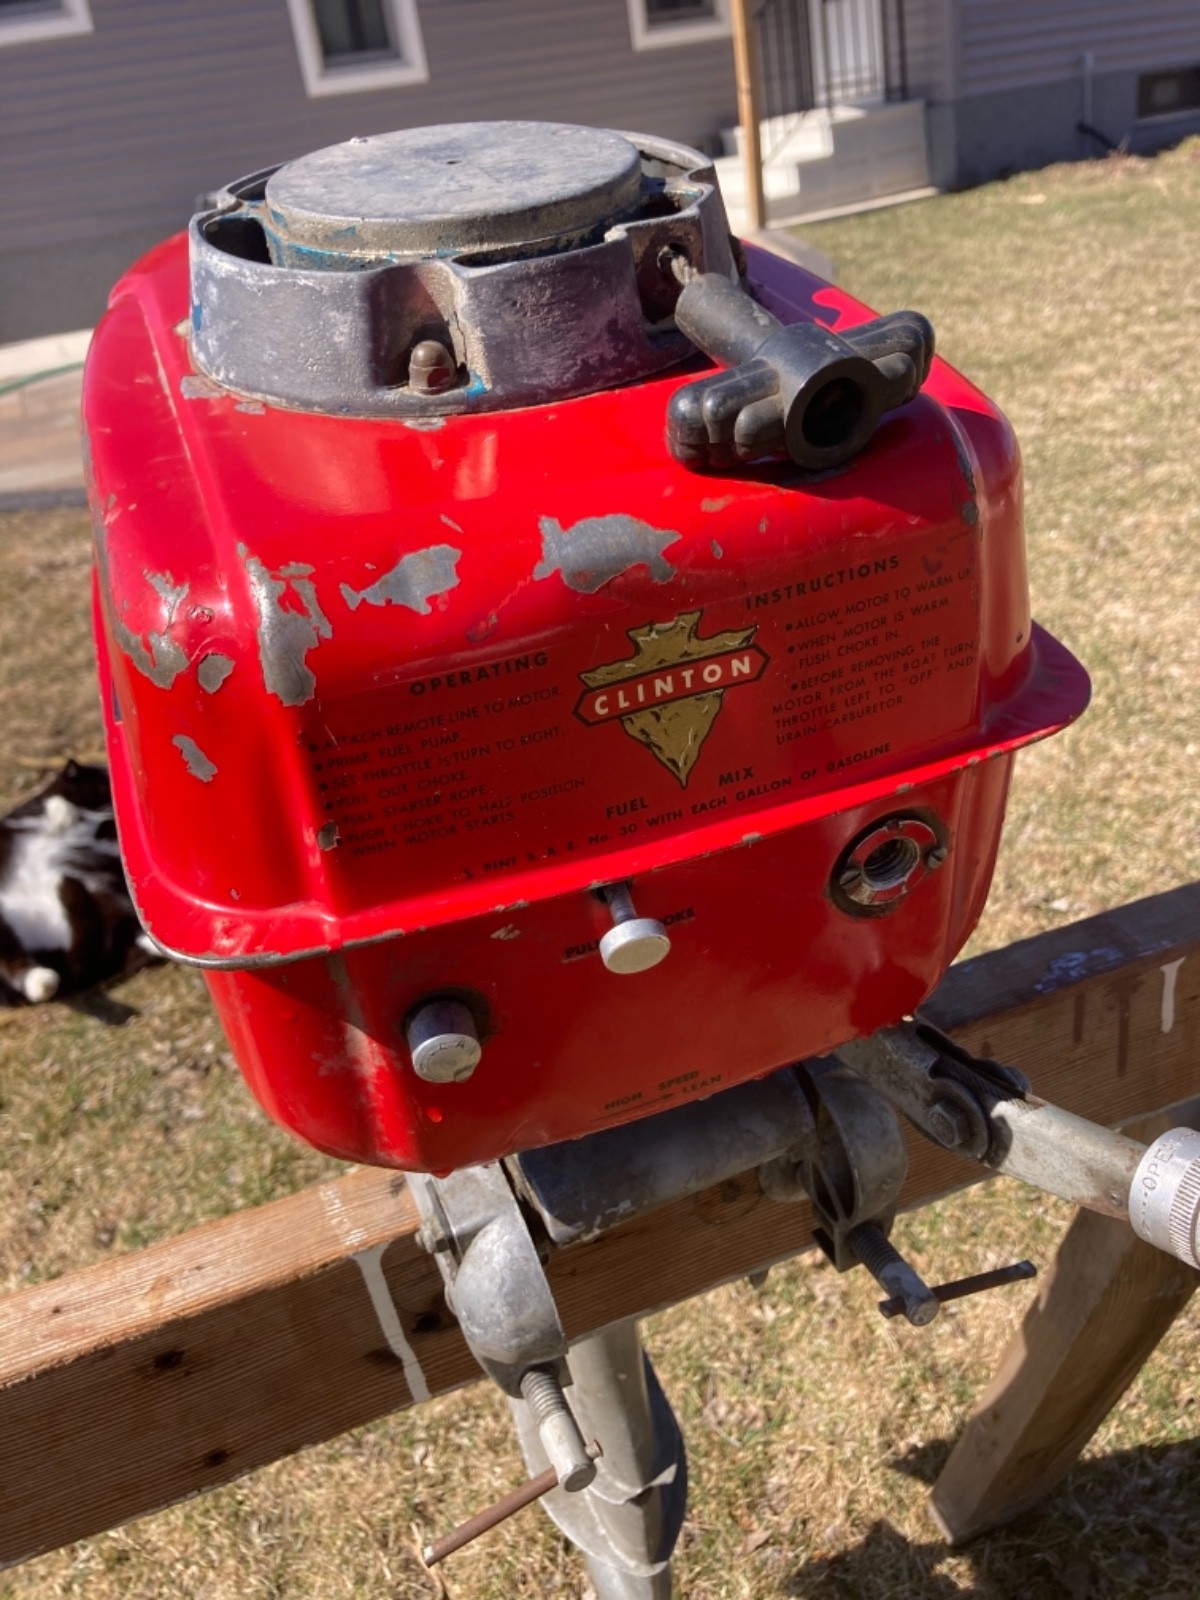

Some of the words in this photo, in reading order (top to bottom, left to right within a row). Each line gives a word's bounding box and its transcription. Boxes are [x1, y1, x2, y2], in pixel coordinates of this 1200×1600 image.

[745, 556, 900, 610] INSTRUCTIONS
[796, 609, 839, 630] ALLOW
[845, 593, 889, 617] MOTOR
[895, 587, 910, 600] TO
[916, 574, 953, 593] WARM
[798, 632, 836, 652] WHEN
[843, 616, 887, 639] MOTOR
[893, 610, 904, 623] IS
[911, 598, 949, 617] WARM
[837, 636, 878, 657] CHOKE
[885, 630, 898, 642] IN
[410, 651, 549, 696] OPERATING
[772, 691, 822, 714] MOTOR
[829, 677, 865, 695] FROM
[873, 667, 895, 681] THE
[902, 652, 936, 672] BOAT
[943, 640, 974, 658] TURN
[800, 668, 844, 690] BEFORE
[850, 645, 914, 673] REMOVING
[921, 635, 940, 650] THE
[594, 656, 751, 715] CLINTON
[774, 702, 836, 729] THROTTLE
[844, 691, 869, 707] LEFT
[879, 683, 895, 697] TO
[947, 656, 974, 672] AND
[386, 715, 443, 737] REMOTE
[449, 706, 479, 723] LINE
[484, 702, 504, 715] TO
[776, 724, 817, 745] DRAIN
[327, 751, 369, 768] PRIME
[379, 744, 411, 758] FUEL
[363, 758, 432, 781] THROTTLE
[452, 744, 490, 762] TURN
[495, 739, 515, 752] TO
[377, 783, 408, 799] OUT
[383, 794, 441, 817] STARTER
[392, 815, 442, 833] CHOKE
[450, 812, 470, 823] TO
[479, 801, 513, 818] HALF
[520, 782, 585, 808] POSITION
[605, 797, 649, 820] FUEL
[718, 766, 754, 787] MIX
[619, 823, 638, 836] 30
[646, 809, 683, 827] WITH
[691, 797, 727, 815] EACH
[735, 776, 792, 801] GALLON
[800, 767, 818, 781] OF
[826, 742, 891, 772] GASOLINE
[352, 840, 397, 857] WHEN
[405, 829, 457, 845] MOTOR
[604, 1091, 642, 1110] HIGH
[658, 1070, 699, 1090] SPEED
[682, 1074, 721, 1094] LEAN
